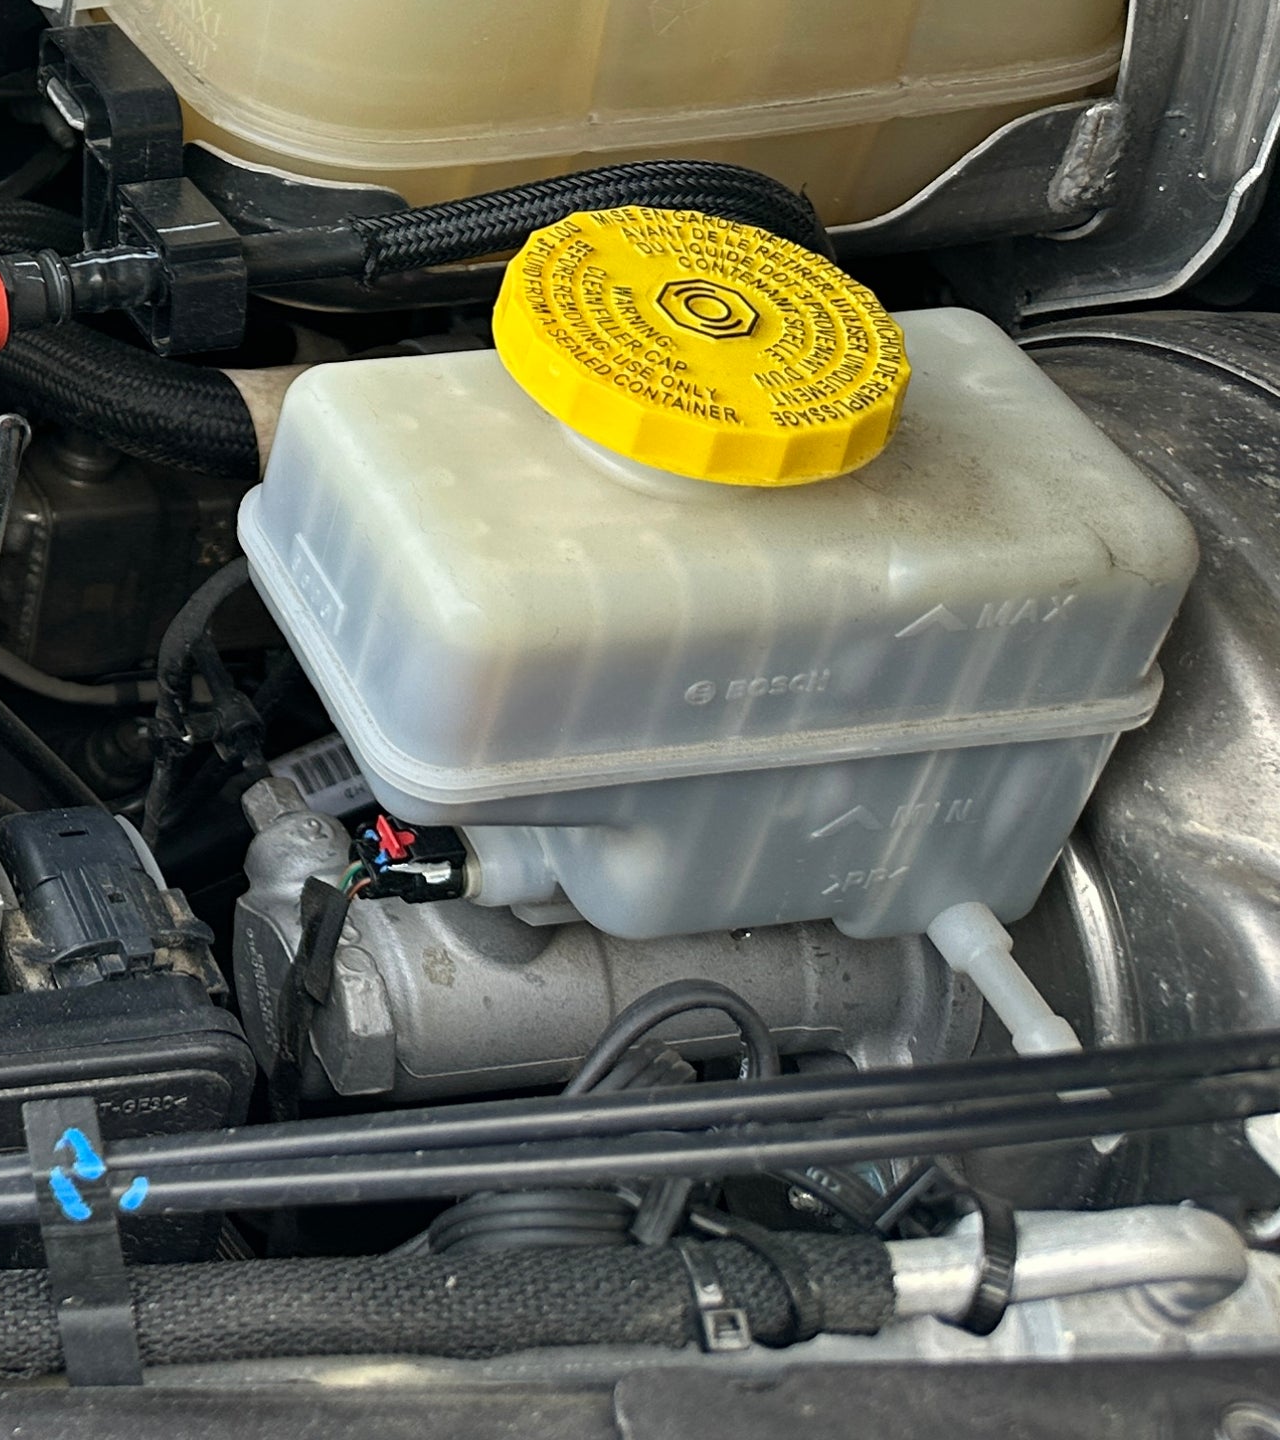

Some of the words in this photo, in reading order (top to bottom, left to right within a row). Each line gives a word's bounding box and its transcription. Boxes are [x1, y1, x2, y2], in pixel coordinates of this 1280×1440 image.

[591, 209, 636, 227] MISE
[641, 209, 666, 223] EN
[536, 237, 556, 250] 3
[548, 221, 582, 243] DOT
[621, 224, 682, 242] AVANT
[693, 228, 719, 244] DE
[724, 234, 749, 252] LE
[521, 245, 552, 279] FLUID
[633, 240, 665, 255] DU
[667, 240, 755, 268] LIQUIDE
[754, 245, 835, 295] RETIRER
[758, 263, 802, 288] DOT
[522, 279, 551, 315] FROM
[582, 265, 607, 306] CLEAN
[677, 255, 801, 316] CONTENANT
[795, 290, 813, 301] 3
[844, 279, 874, 303] LE
[540, 317, 557, 327] A
[551, 239, 595, 282] BEFORE
[612, 353, 655, 379] USE
[660, 374, 718, 402] ONLY
[592, 308, 643, 352] FILLER
[861, 299, 902, 361] BOUCHON
[548, 327, 613, 376] SEALED
[798, 301, 838, 376] PROVENANT
[643, 349, 688, 372] CAP
[876, 362, 900, 383] DE
[769, 352, 867, 407] UNIQUEMENT
[770, 378, 889, 427] REMPLISSAGE
[975, 594, 1077, 630] MAX
[725, 668, 831, 702] BOSCH
[891, 798, 977, 830] MIN
